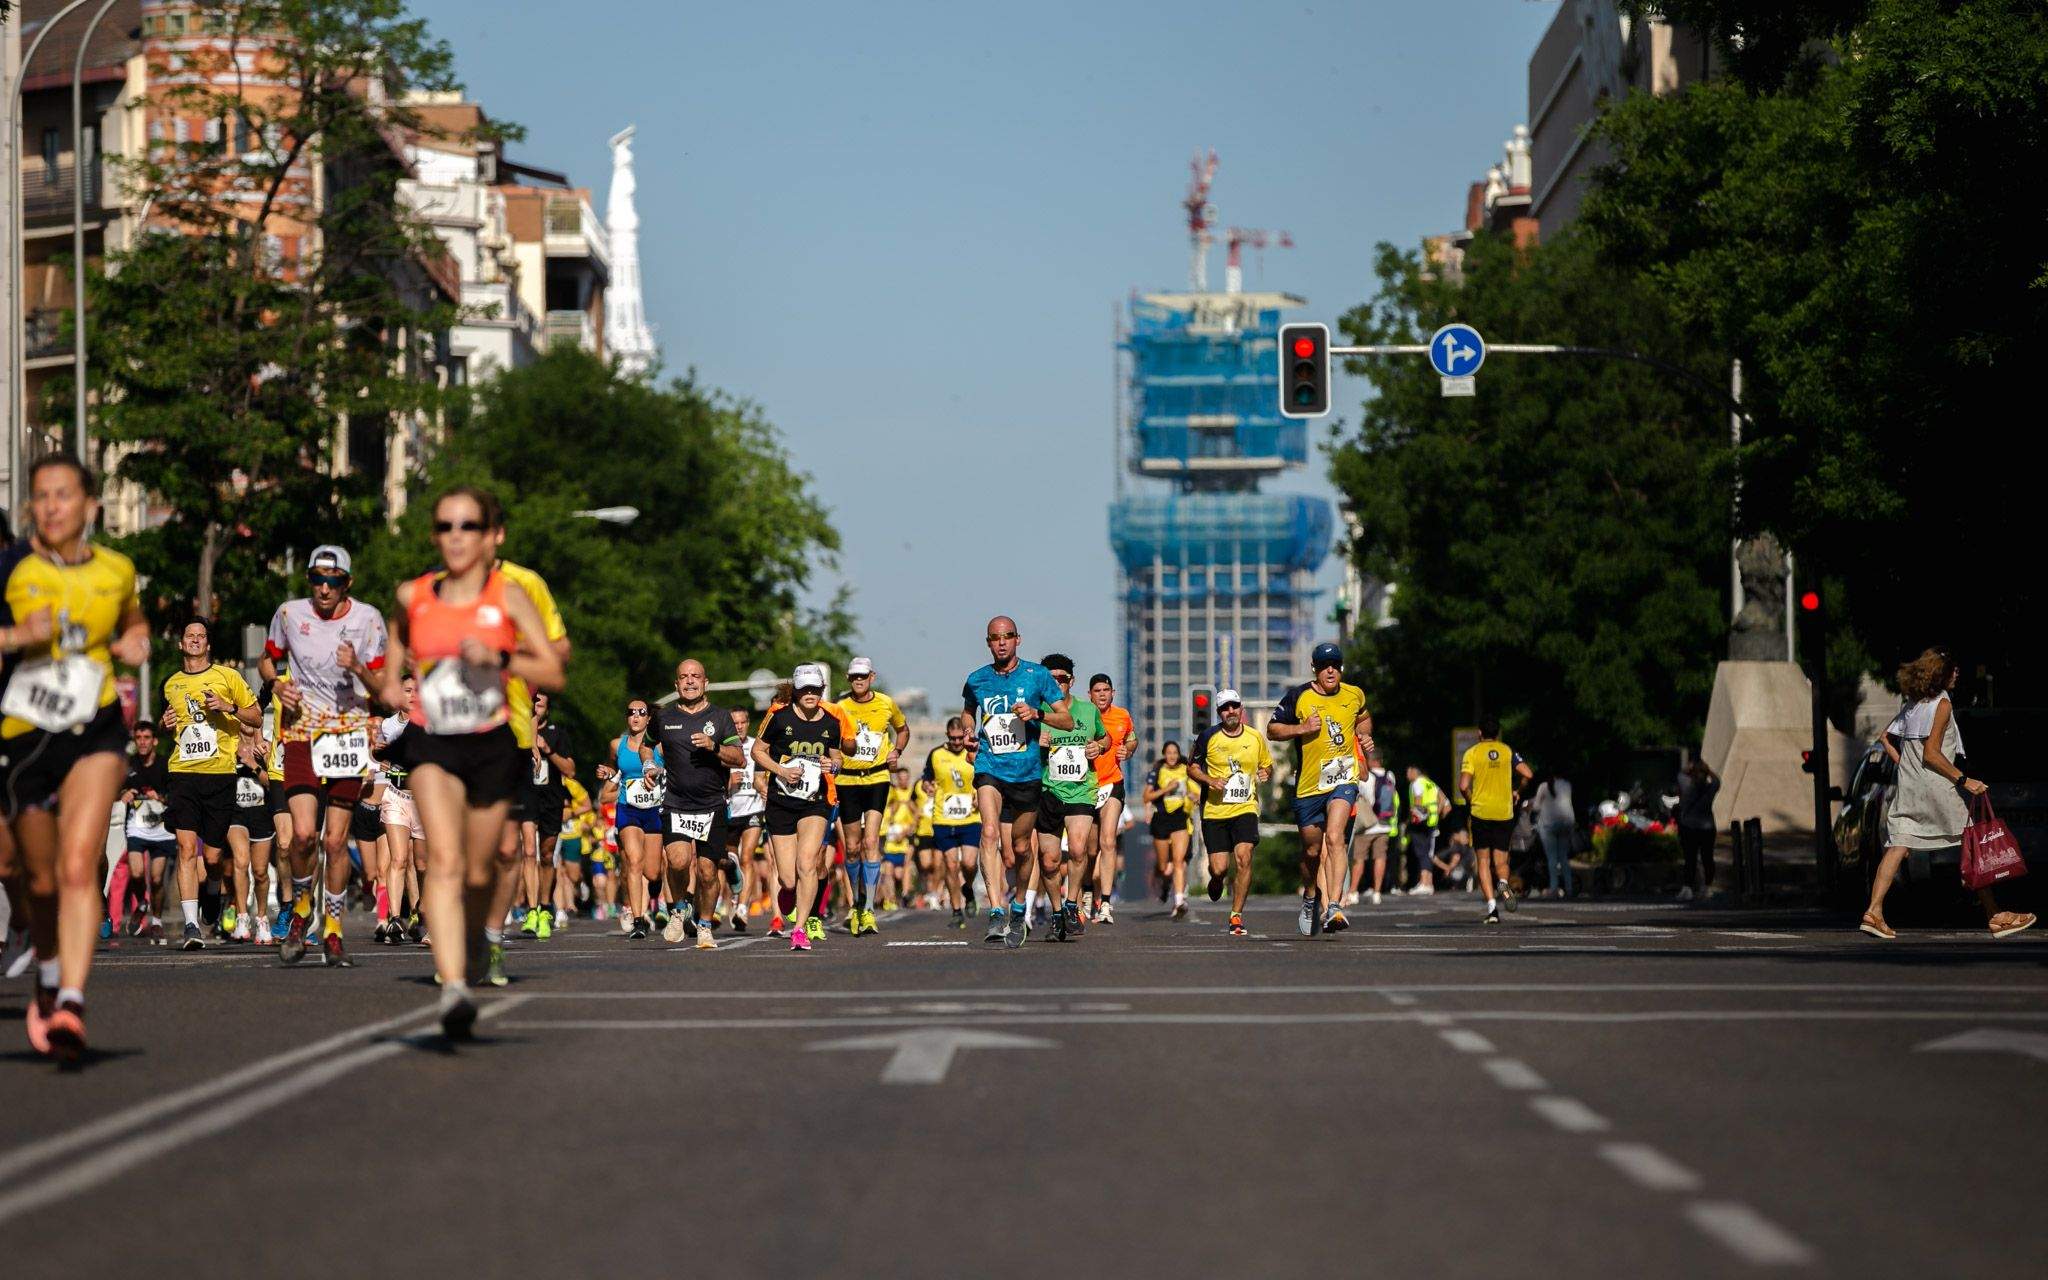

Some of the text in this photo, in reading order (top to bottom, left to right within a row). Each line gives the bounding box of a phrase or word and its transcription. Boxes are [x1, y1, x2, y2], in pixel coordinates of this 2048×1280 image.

[990, 733, 1017, 746] 1504
[186, 741, 211, 754] 3280
[789, 741, 825, 756] 100
[323, 753, 359, 768] 3498
[1057, 764, 1081, 775] 1804
[634, 793, 655, 804] 1584
[1230, 788, 1249, 798] 1889
[679, 819, 704, 833] 2455
